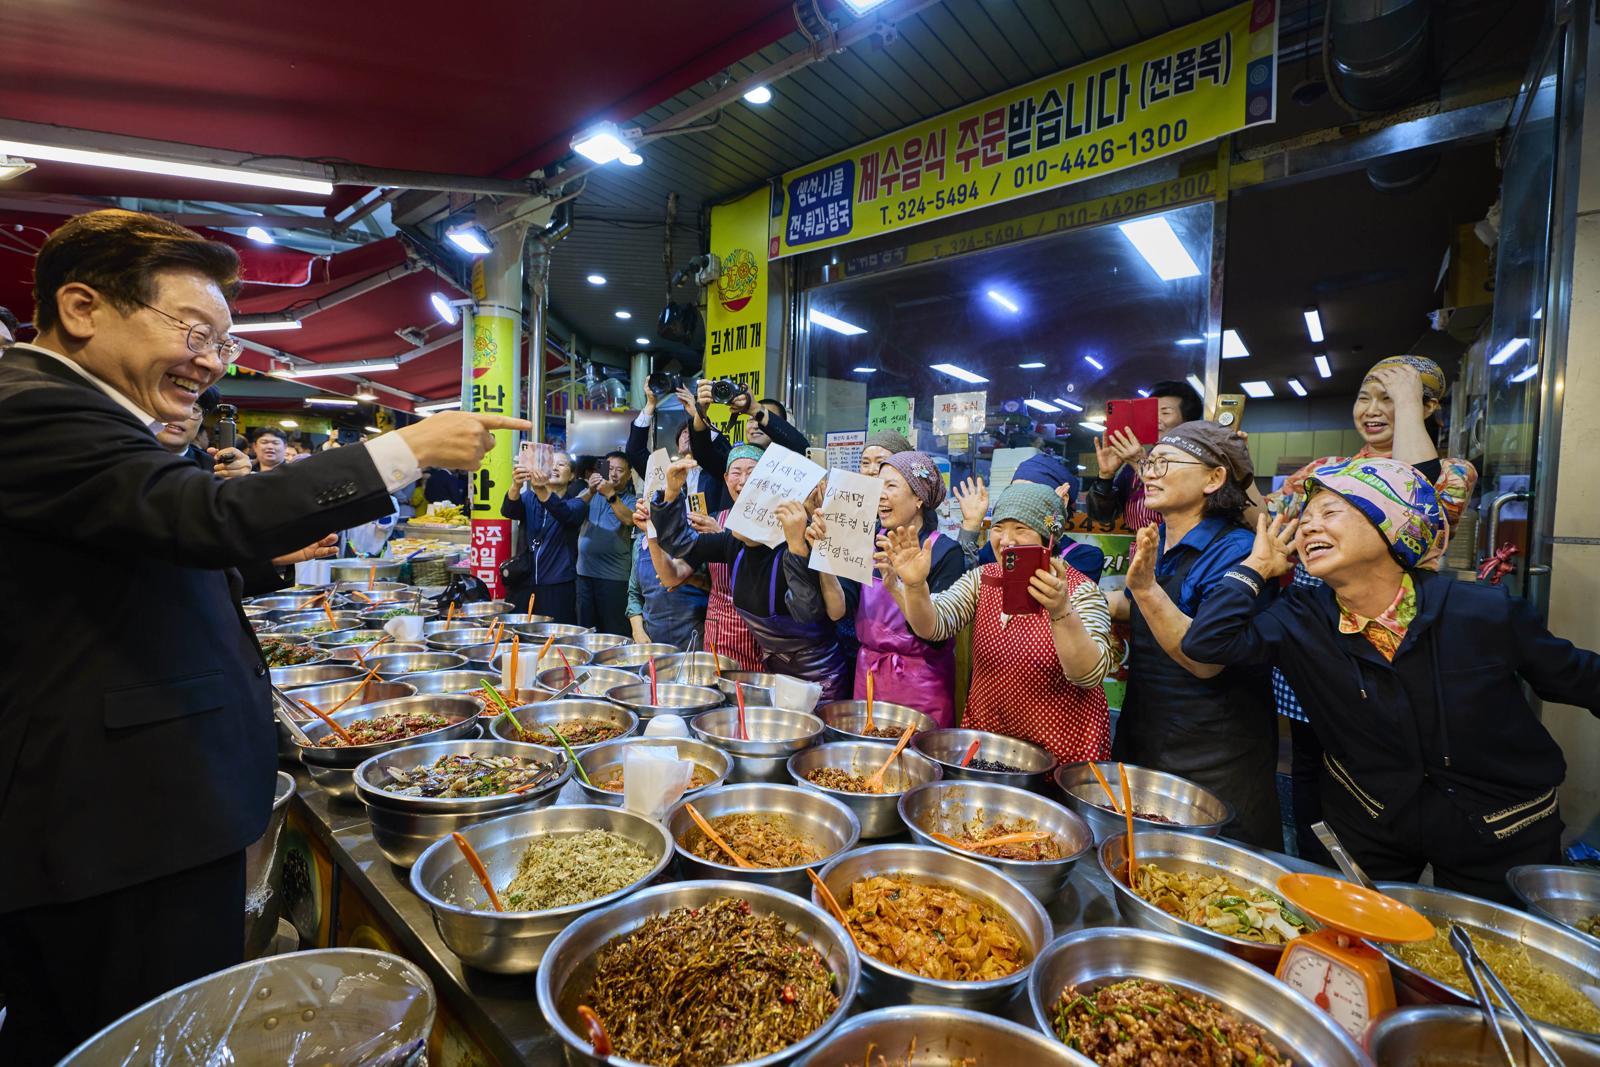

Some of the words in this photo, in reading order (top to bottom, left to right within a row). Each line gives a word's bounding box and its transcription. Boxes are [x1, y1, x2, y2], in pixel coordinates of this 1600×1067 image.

[858, 128, 947, 204] 제수음식
[1140, 31, 1232, 111] (전품목)
[880, 205, 892, 225] T.
[897, 180, 979, 221] 324-5494
[1013, 118, 1188, 189] 010-4426-1300
[711, 322, 762, 355] 김치찌개
[826, 487, 865, 508] 이재명
